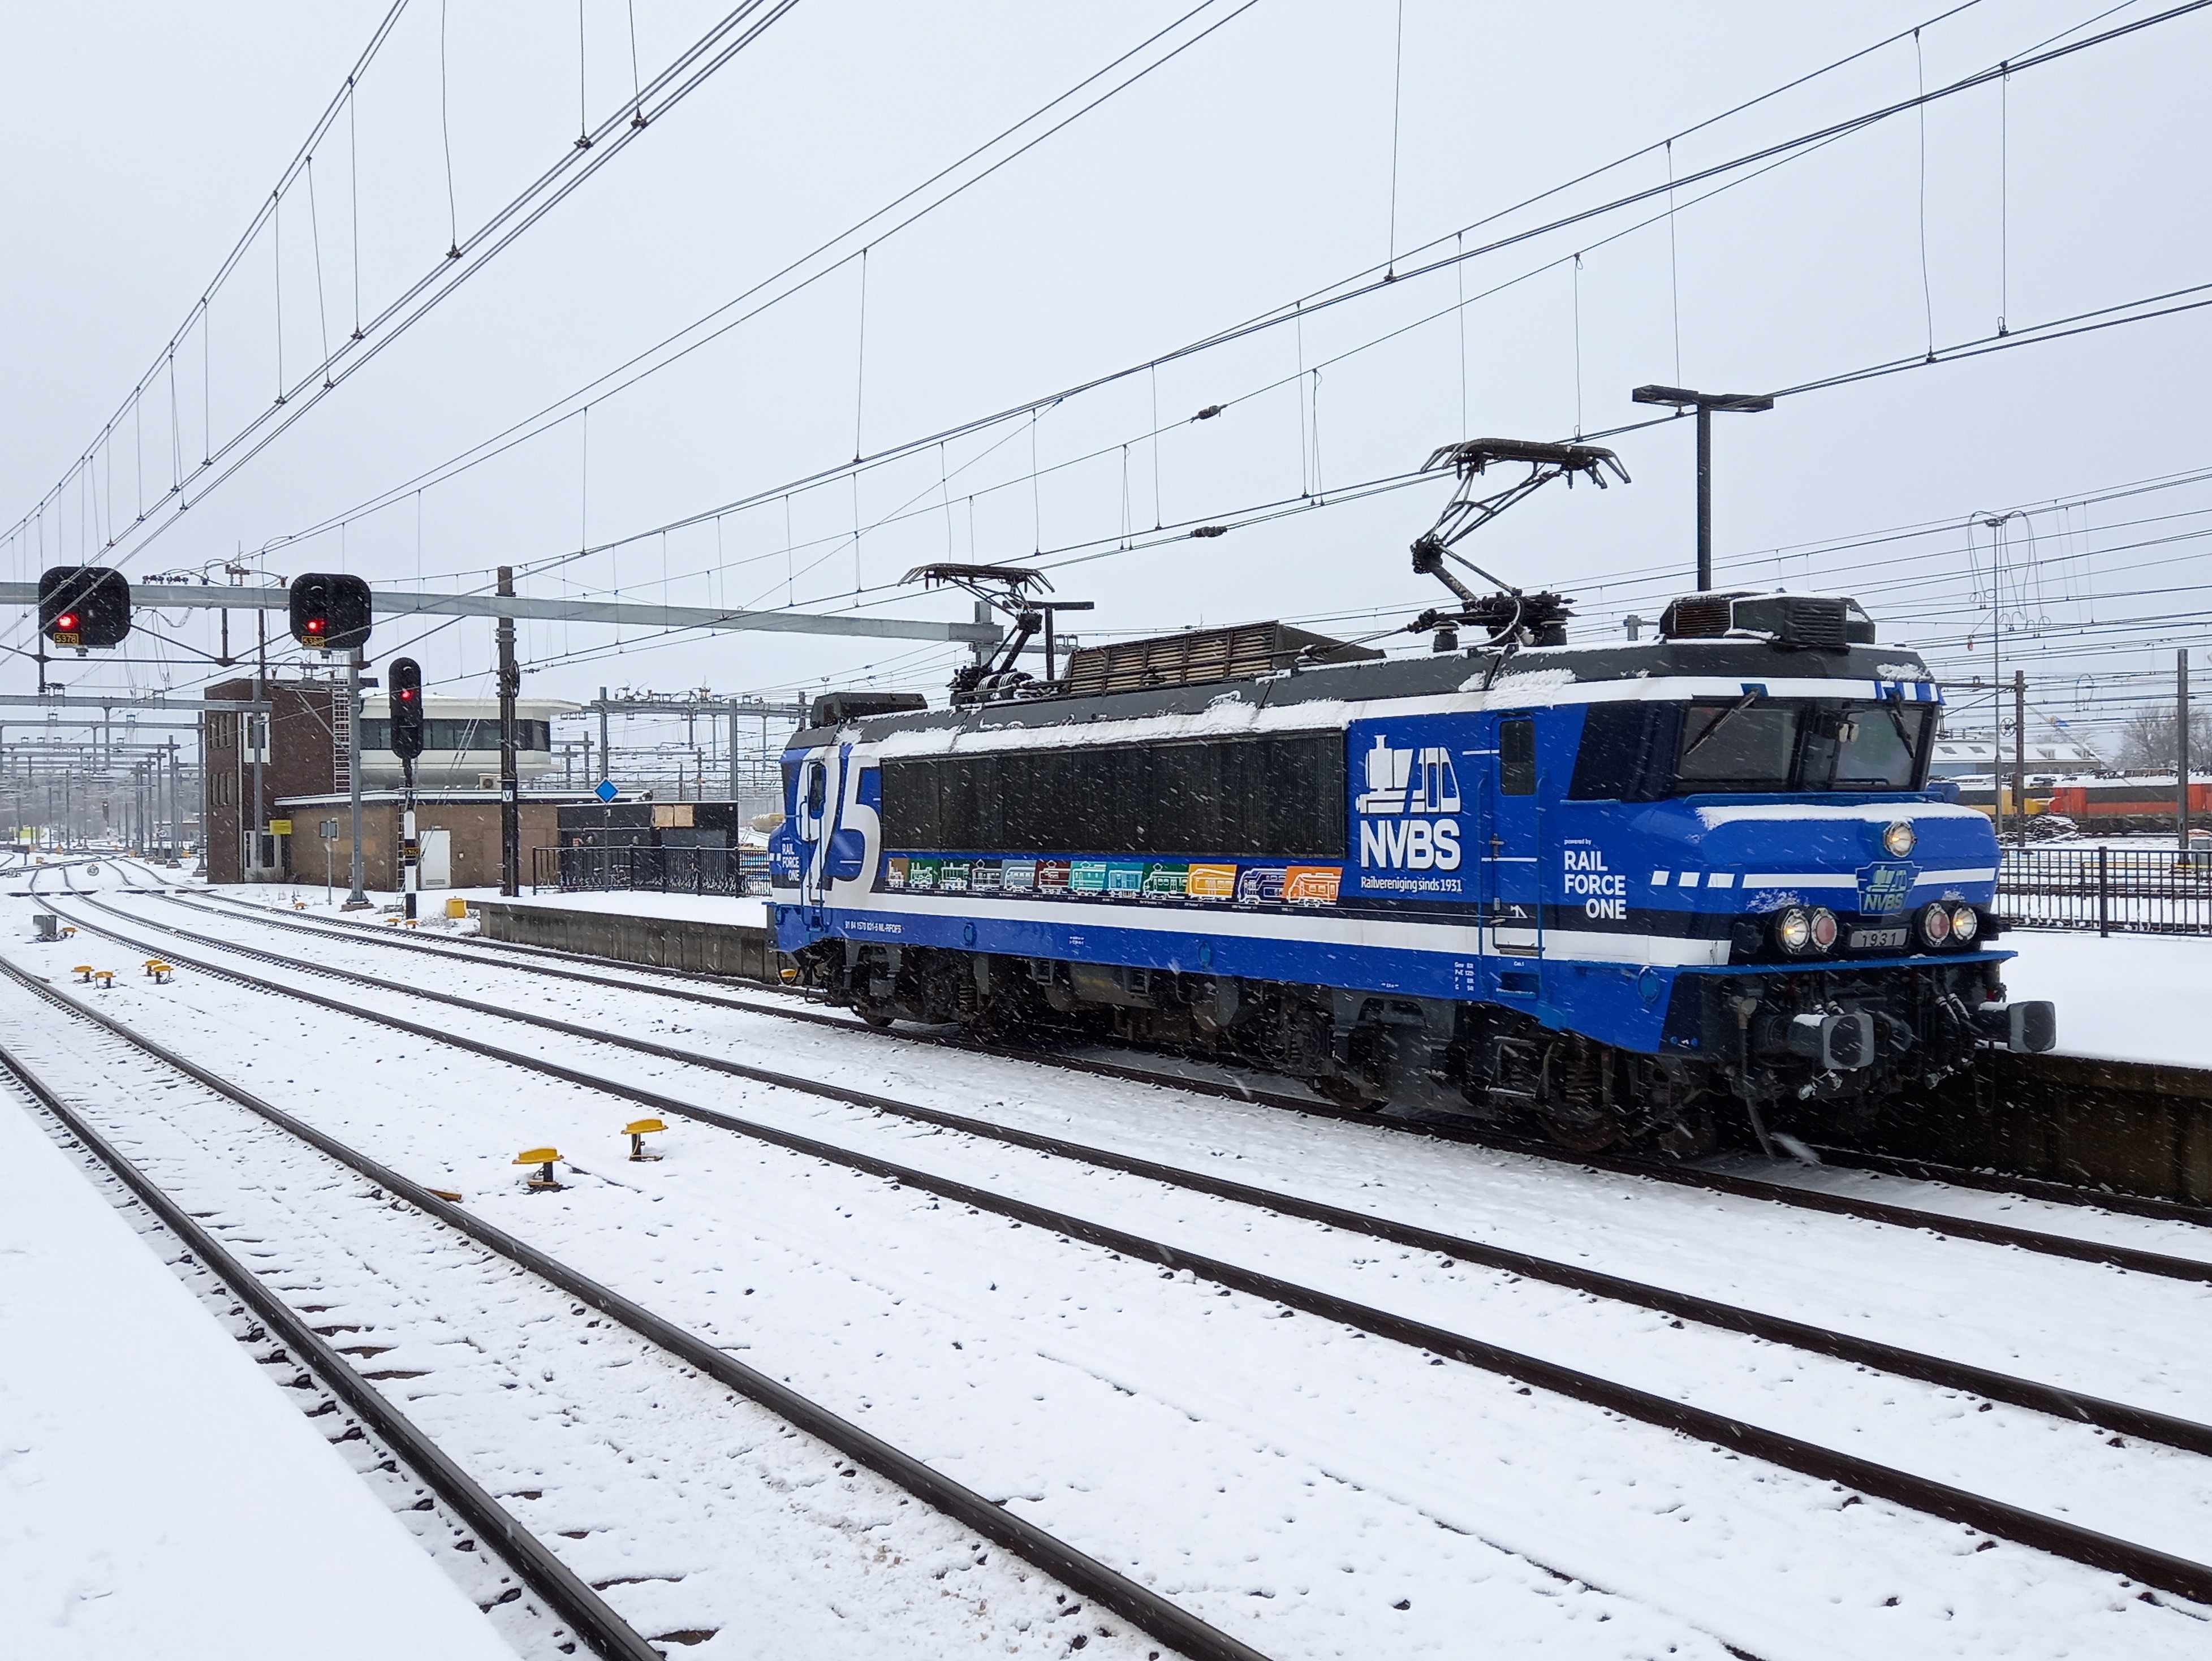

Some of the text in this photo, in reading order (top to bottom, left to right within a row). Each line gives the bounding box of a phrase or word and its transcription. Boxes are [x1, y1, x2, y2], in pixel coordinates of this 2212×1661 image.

[56, 635, 76, 643] 5378
[504, 791, 511, 800] V
[782, 843, 795, 855] RAIL
[1360, 818, 1461, 870] NVBS
[782, 856, 799, 868] FORCE
[1564, 850, 1608, 871] RAIL
[788, 869, 800, 881] ONE
[1361, 876, 1462, 893] Railvereniging sinds 1931
[1564, 874, 1626, 895] FORCE
[1586, 898, 1627, 920] ONE
[1864, 893, 1904, 911] NVBS
[1862, 932, 1896, 947] 1931
